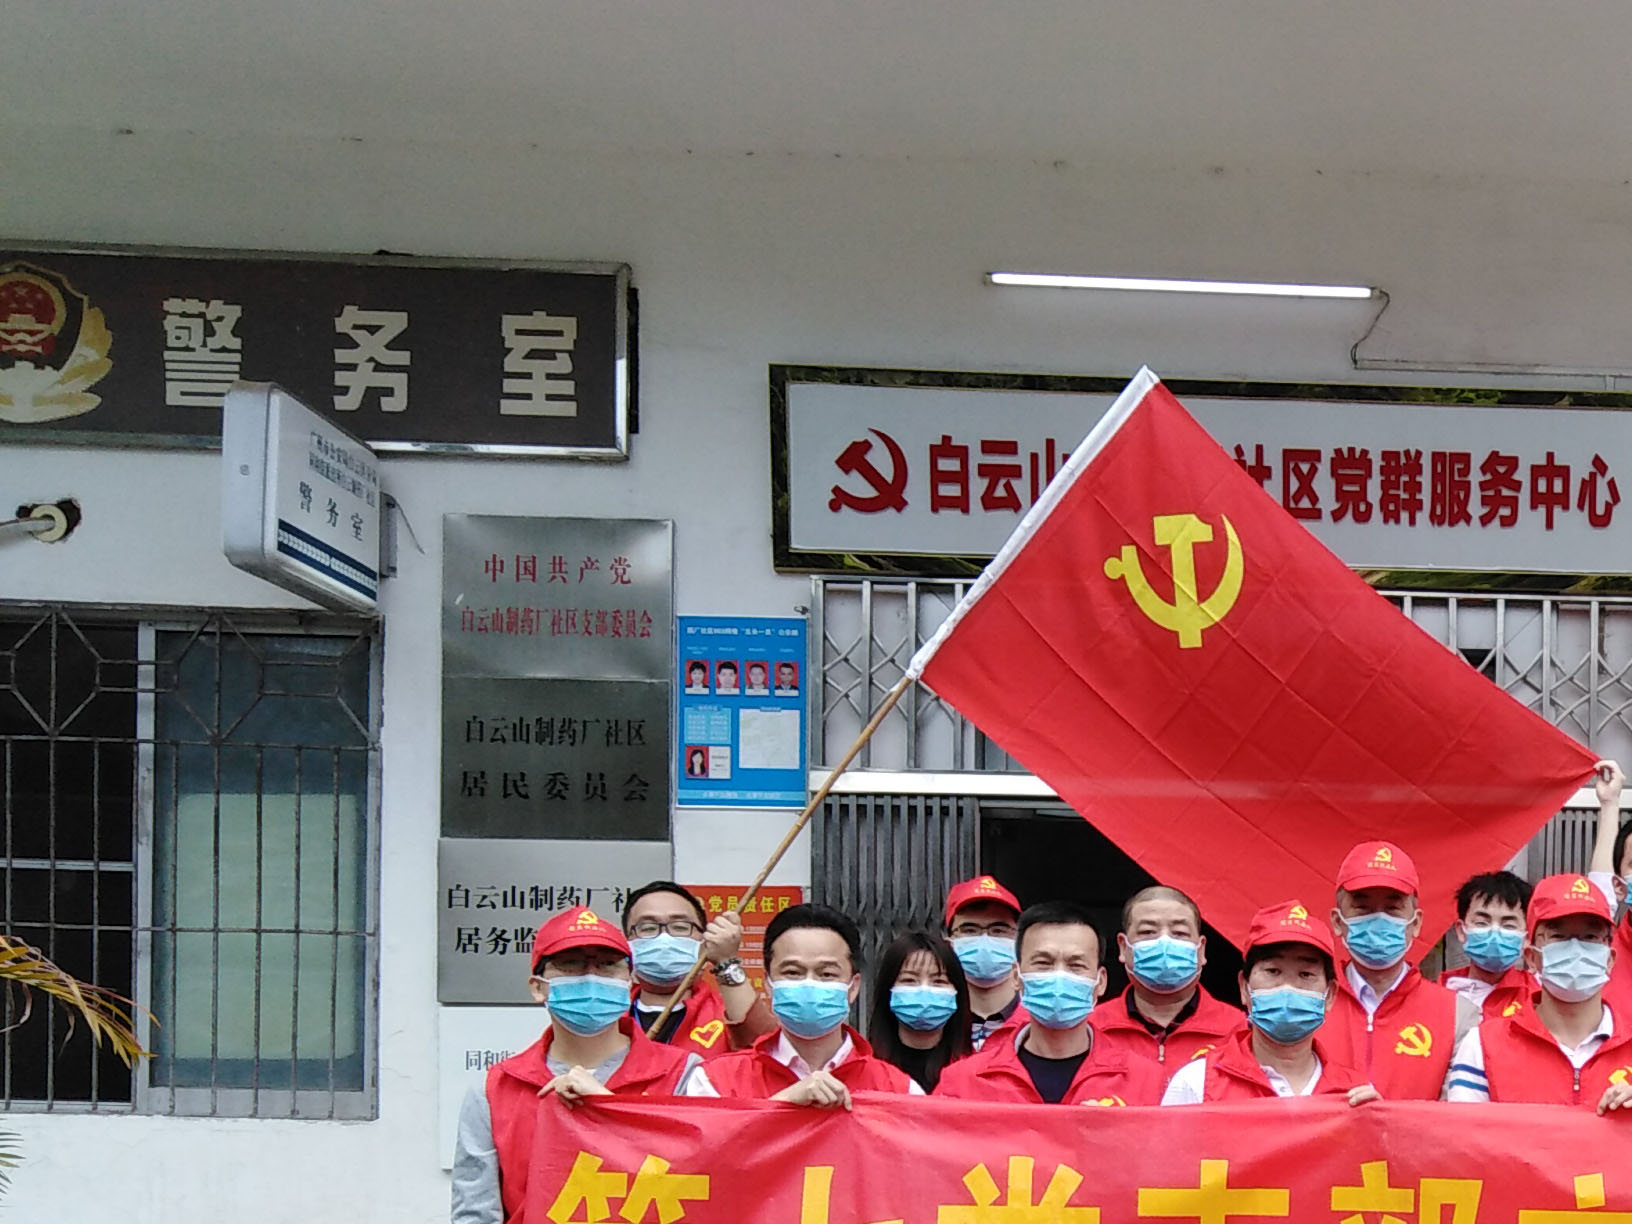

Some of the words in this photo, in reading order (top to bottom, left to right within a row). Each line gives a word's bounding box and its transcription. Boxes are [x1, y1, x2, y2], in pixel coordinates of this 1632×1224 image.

[162, 297, 578, 418] 警务室
[929, 432, 1622, 531] 白云山社区党群服务中心
[484, 555, 633, 586] 中国共产党
[460, 606, 654, 640] 白云山制药厂社区支部委员会
[464, 716, 647, 748] 白云山制药厂社区
[459, 770, 650, 802] 居民委员会
